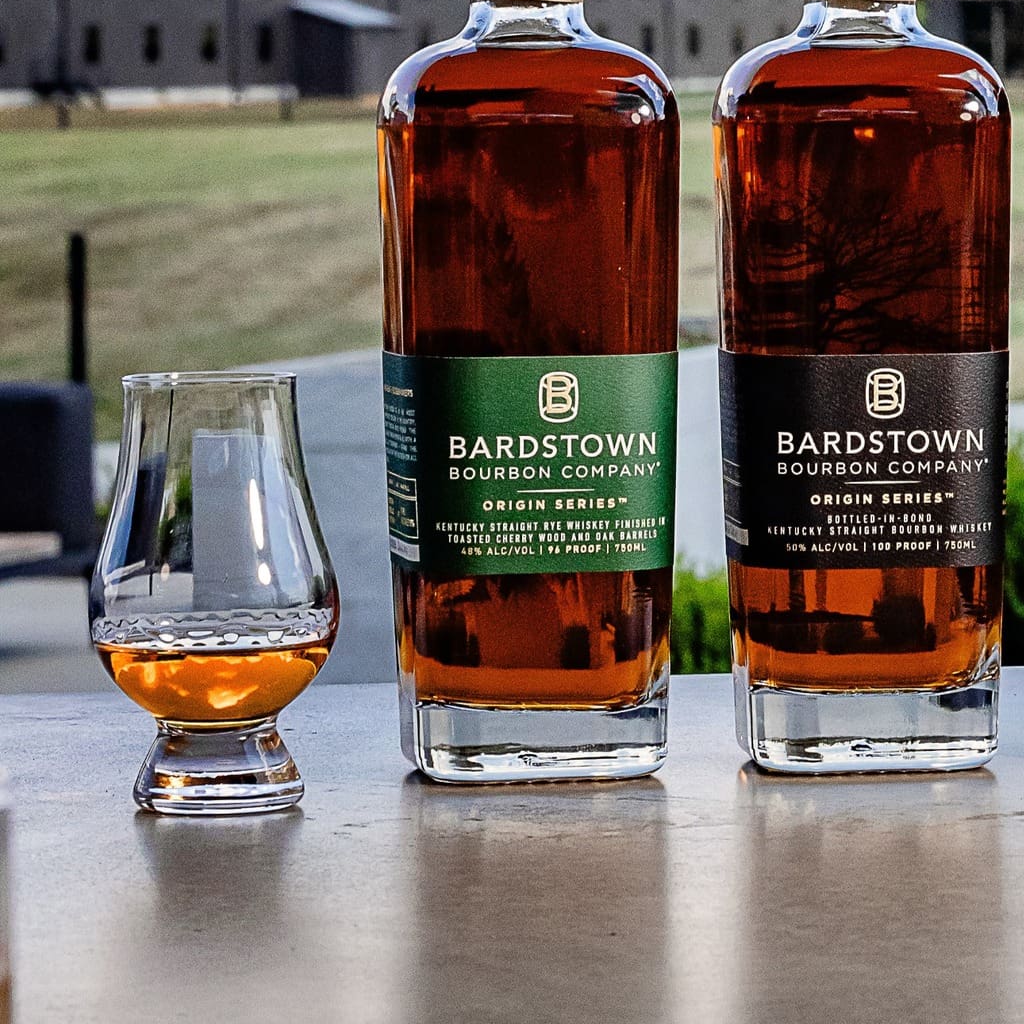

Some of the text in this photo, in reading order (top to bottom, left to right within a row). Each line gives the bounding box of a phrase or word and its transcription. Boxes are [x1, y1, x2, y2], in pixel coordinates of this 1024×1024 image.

[546, 376, 572, 413] B
[873, 374, 899, 411] B
[449, 432, 656, 459] BARDSTOWN
[777, 429, 984, 455] BARDSTOWN
[450, 466, 550, 480] BOURBON
[778, 462, 877, 475] BOURBON
[483, 500, 545, 511] ORIGIN
[810, 494, 873, 505] ORIGIN
[436, 522, 484, 532] KENTUCKY
[490, 522, 538, 531] STRAIGHT
[544, 521, 561, 531] RYE
[567, 520, 609, 530] WHISKEY
[615, 518, 655, 528] FINISHED
[828, 514, 932, 524] BOTTLED-IN-BOND
[448, 529, 657, 543] TOASTED CHERRY WOOD AND OAK BARRELS
[768, 522, 992, 536] KENTUCKY STRAIGHT BOURBON WHISKEY
[461, 543, 646, 556] 48% ALC/VOL 96 PROOF 750ML
[786, 540, 976, 552] 50% ALC/VOL 100 PROOF 750ML
